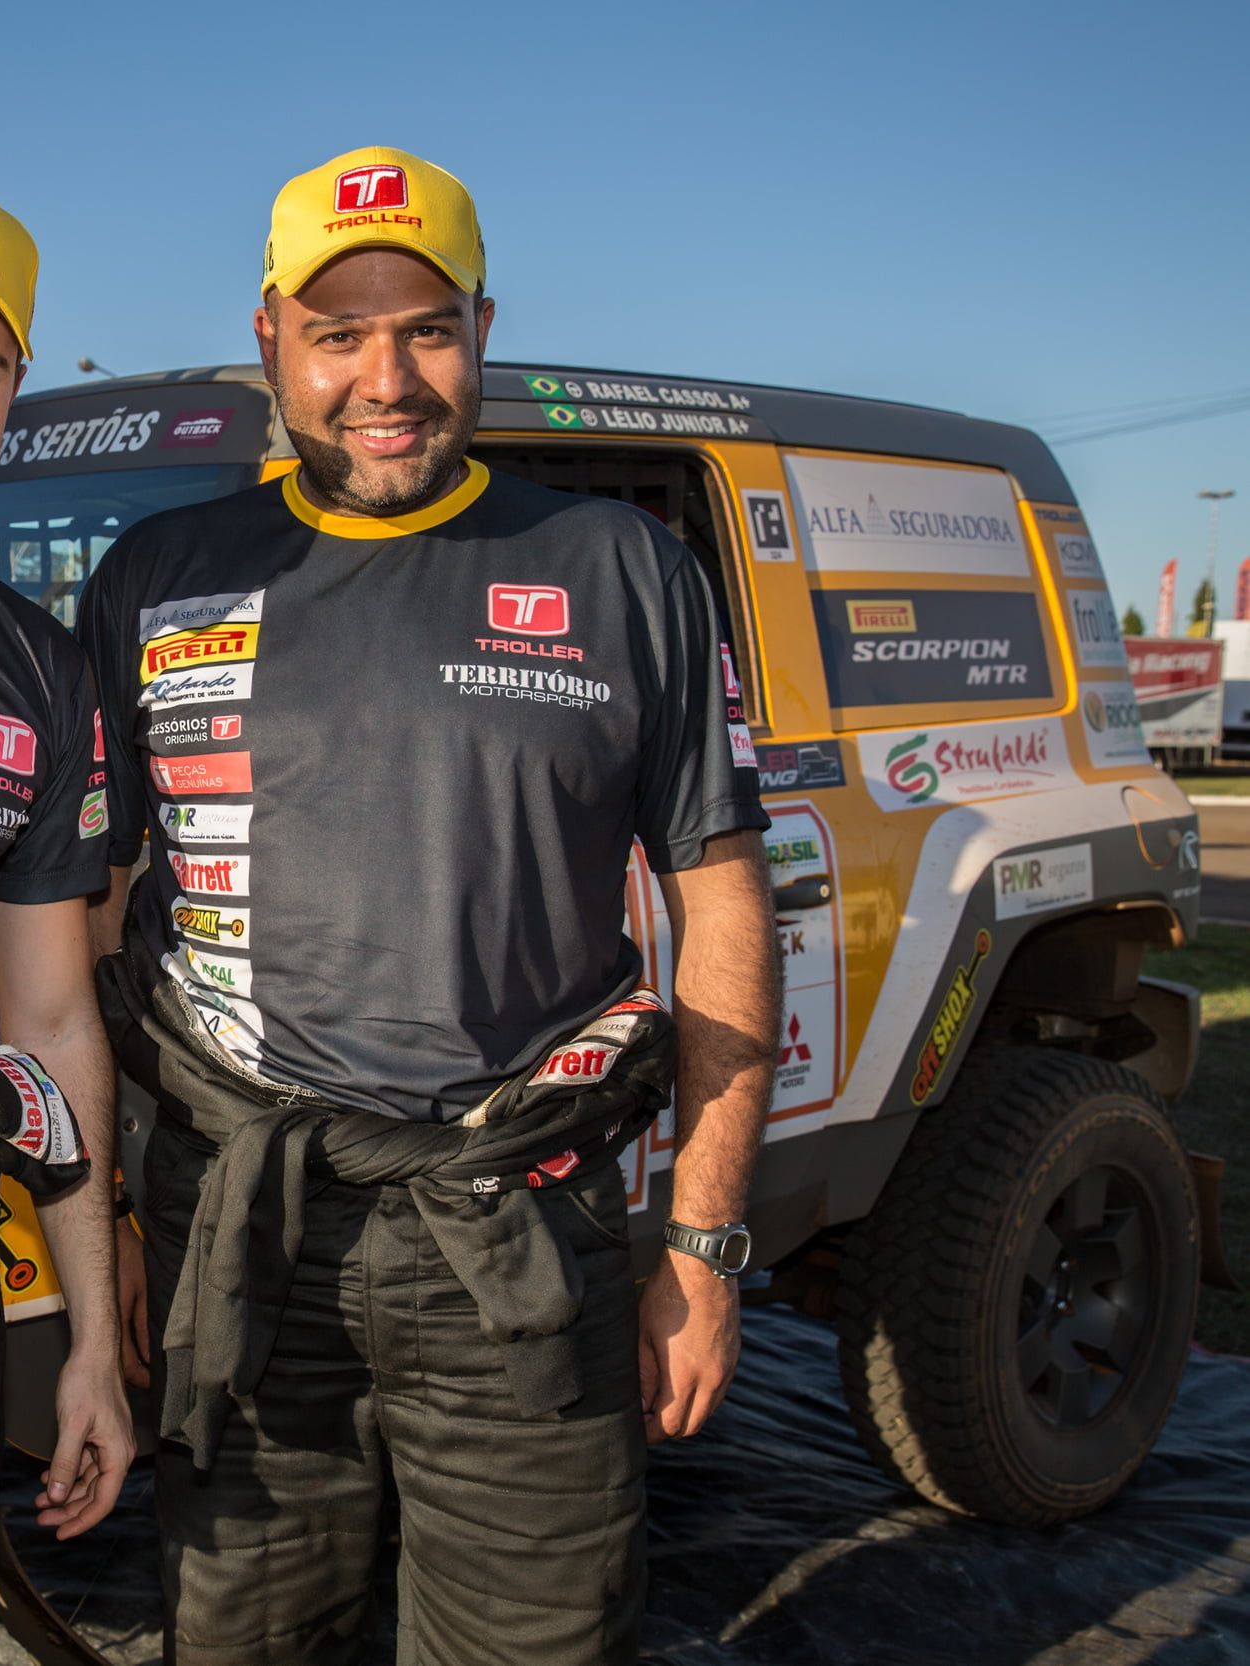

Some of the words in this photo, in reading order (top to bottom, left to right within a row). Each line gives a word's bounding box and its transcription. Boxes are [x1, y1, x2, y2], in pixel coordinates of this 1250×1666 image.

[323, 213, 423, 234] TROLLER
[586, 381, 654, 404] RAFAEL
[658, 387, 728, 409] CASSOL
[173, 425, 223, 437] OUTBACK
[601, 406, 657, 430] LÉLIO
[661, 413, 727, 434] JUNIOR
[22, 406, 161, 463] SERTÕES
[809, 506, 864, 535] ALFA
[889, 509, 1016, 544] SEGURADORA
[180, 601, 255, 621] SEGURADORA
[853, 605, 911, 628] PIRELLI
[146, 630, 248, 675] PIRELLI
[474, 638, 584, 663] TROLLER
[851, 638, 1011, 663] SCORPION
[148, 671, 237, 704] Gabardo
[439, 664, 612, 703] TERRITÓRIO
[966, 664, 1028, 686] MTR
[459, 684, 595, 712] MOTORSPORT
[164, 732, 209, 745] ORIGINAIS
[934, 731, 1049, 775] Strufaldi
[171, 764, 208, 779] PEÇAS
[174, 776, 224, 789] GENUÍNAS
[164, 807, 197, 827] PMR
[172, 854, 233, 892] Garrett
[1000, 859, 1043, 895] PMR
